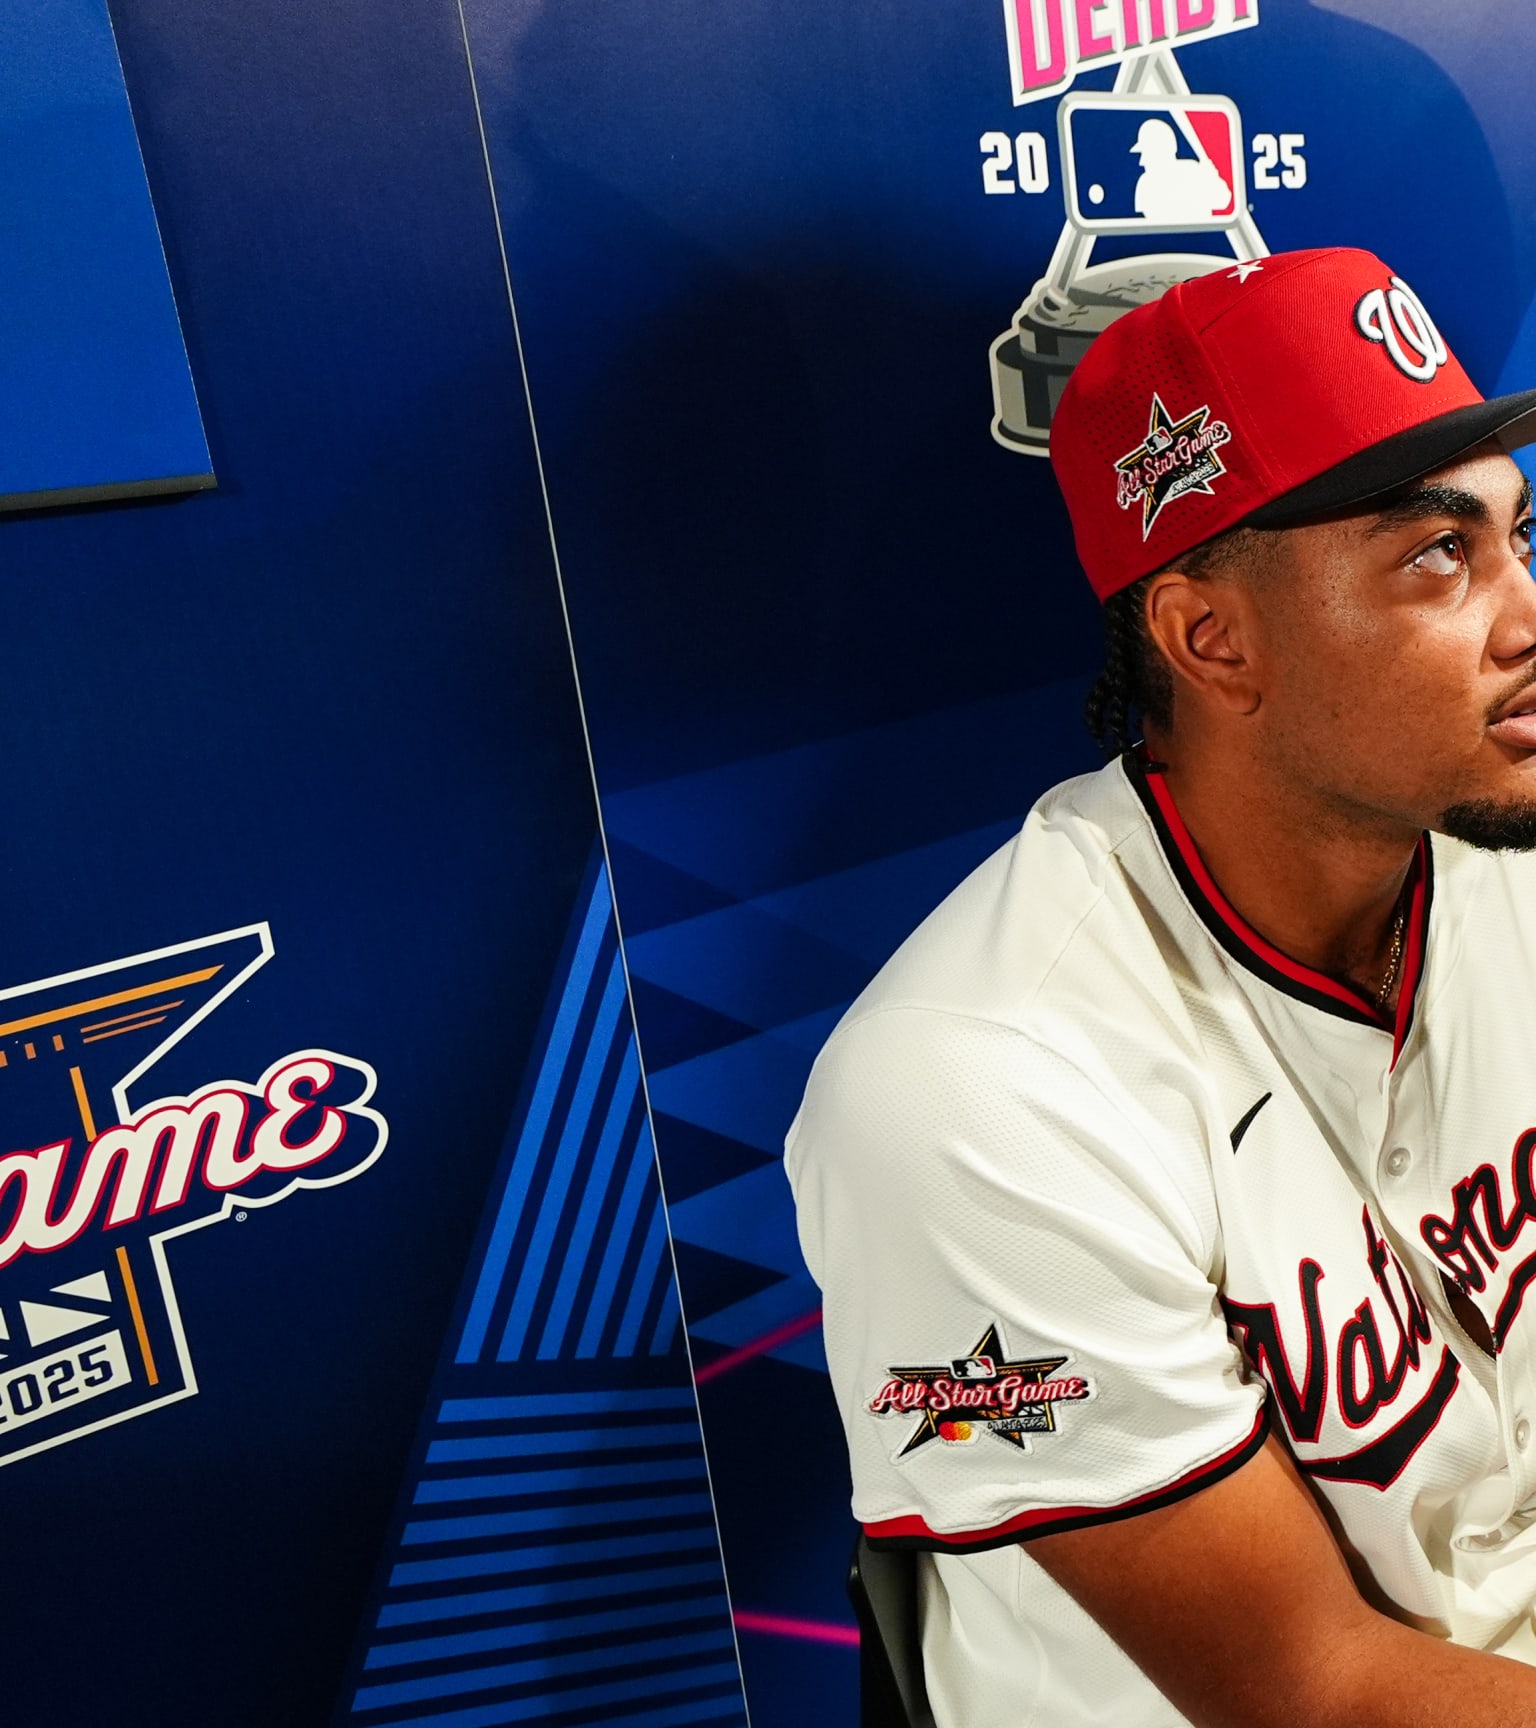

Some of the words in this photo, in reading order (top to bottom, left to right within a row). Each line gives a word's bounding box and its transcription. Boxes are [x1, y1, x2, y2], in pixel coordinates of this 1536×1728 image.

[979, 131, 1050, 195] 20
[1252, 133, 1307, 190] 25
[1354, 276, 1448, 384] W
[1143, 448, 1182, 485] Star
[1175, 422, 1225, 466] Game
[0, 1344, 114, 1425] 025
[869, 1378, 927, 1413] All
[928, 1377, 997, 1411] Star
[998, 1375, 1089, 1412] Game
